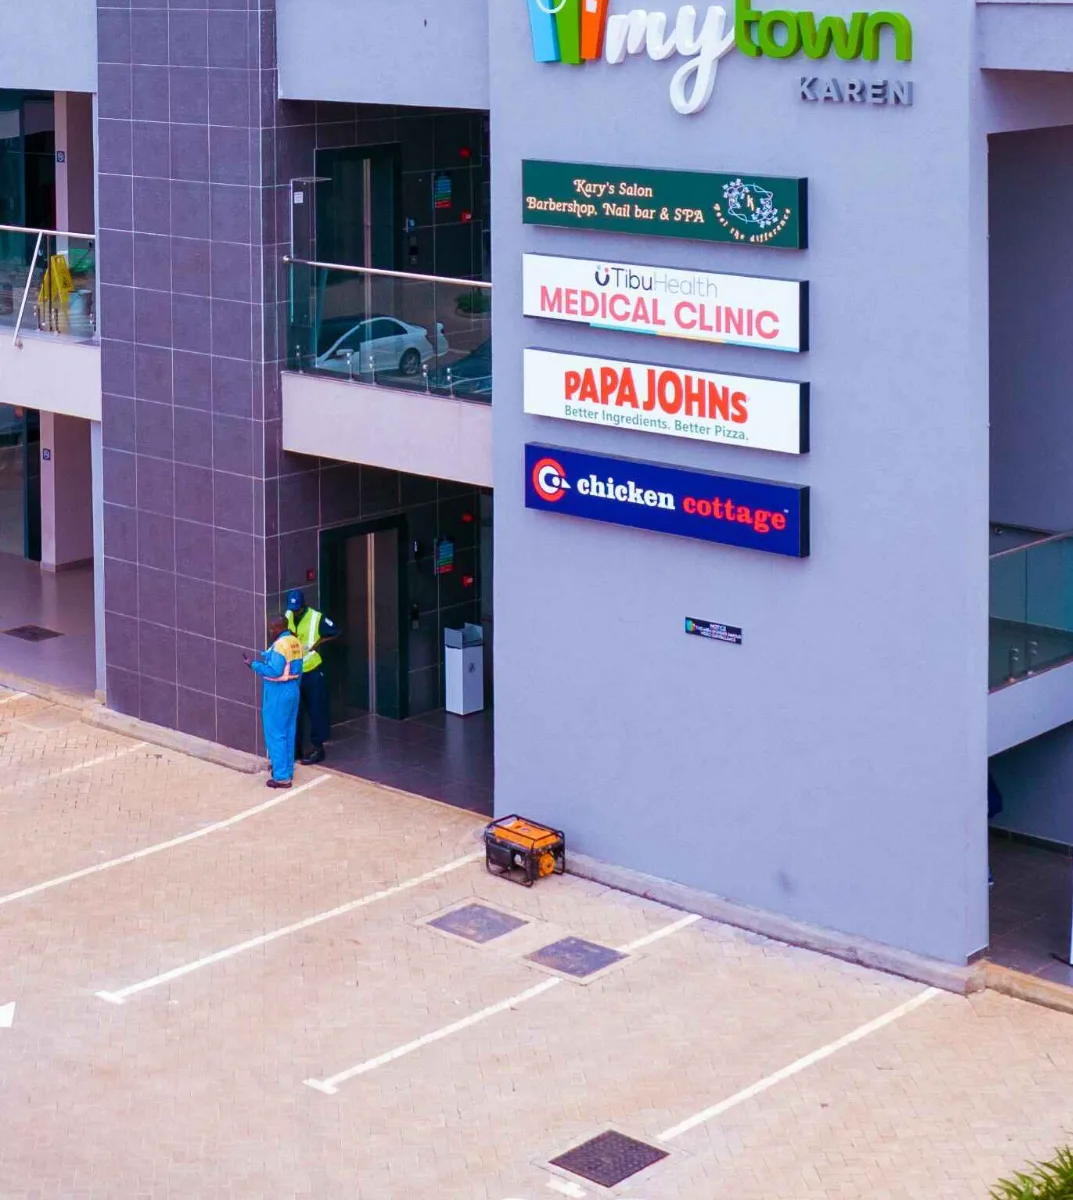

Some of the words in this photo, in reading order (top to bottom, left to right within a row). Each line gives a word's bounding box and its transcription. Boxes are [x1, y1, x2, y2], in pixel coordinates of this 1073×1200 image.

[799, 77, 913, 106] KAREN
[573, 179, 615, 198] Kary's
[619, 182, 653, 197] Salon
[603, 202, 630, 218] Nail
[634, 205, 656, 220] bar
[659, 207, 670, 221] &
[673, 208, 706, 223] SPA
[611, 267, 718, 298] TibuHealth
[540, 285, 666, 326] MEDICAL
[674, 301, 780, 339] CLINIC
[565, 367, 639, 408] PAPA
[643, 369, 748, 424] JOHNS
[565, 405, 599, 420] Better
[602, 411, 671, 430] Ingredients.
[675, 420, 711, 436] Better
[714, 425, 749, 441] Pizza.
[577, 474, 675, 510] chicken
[682, 496, 786, 533] cottage
